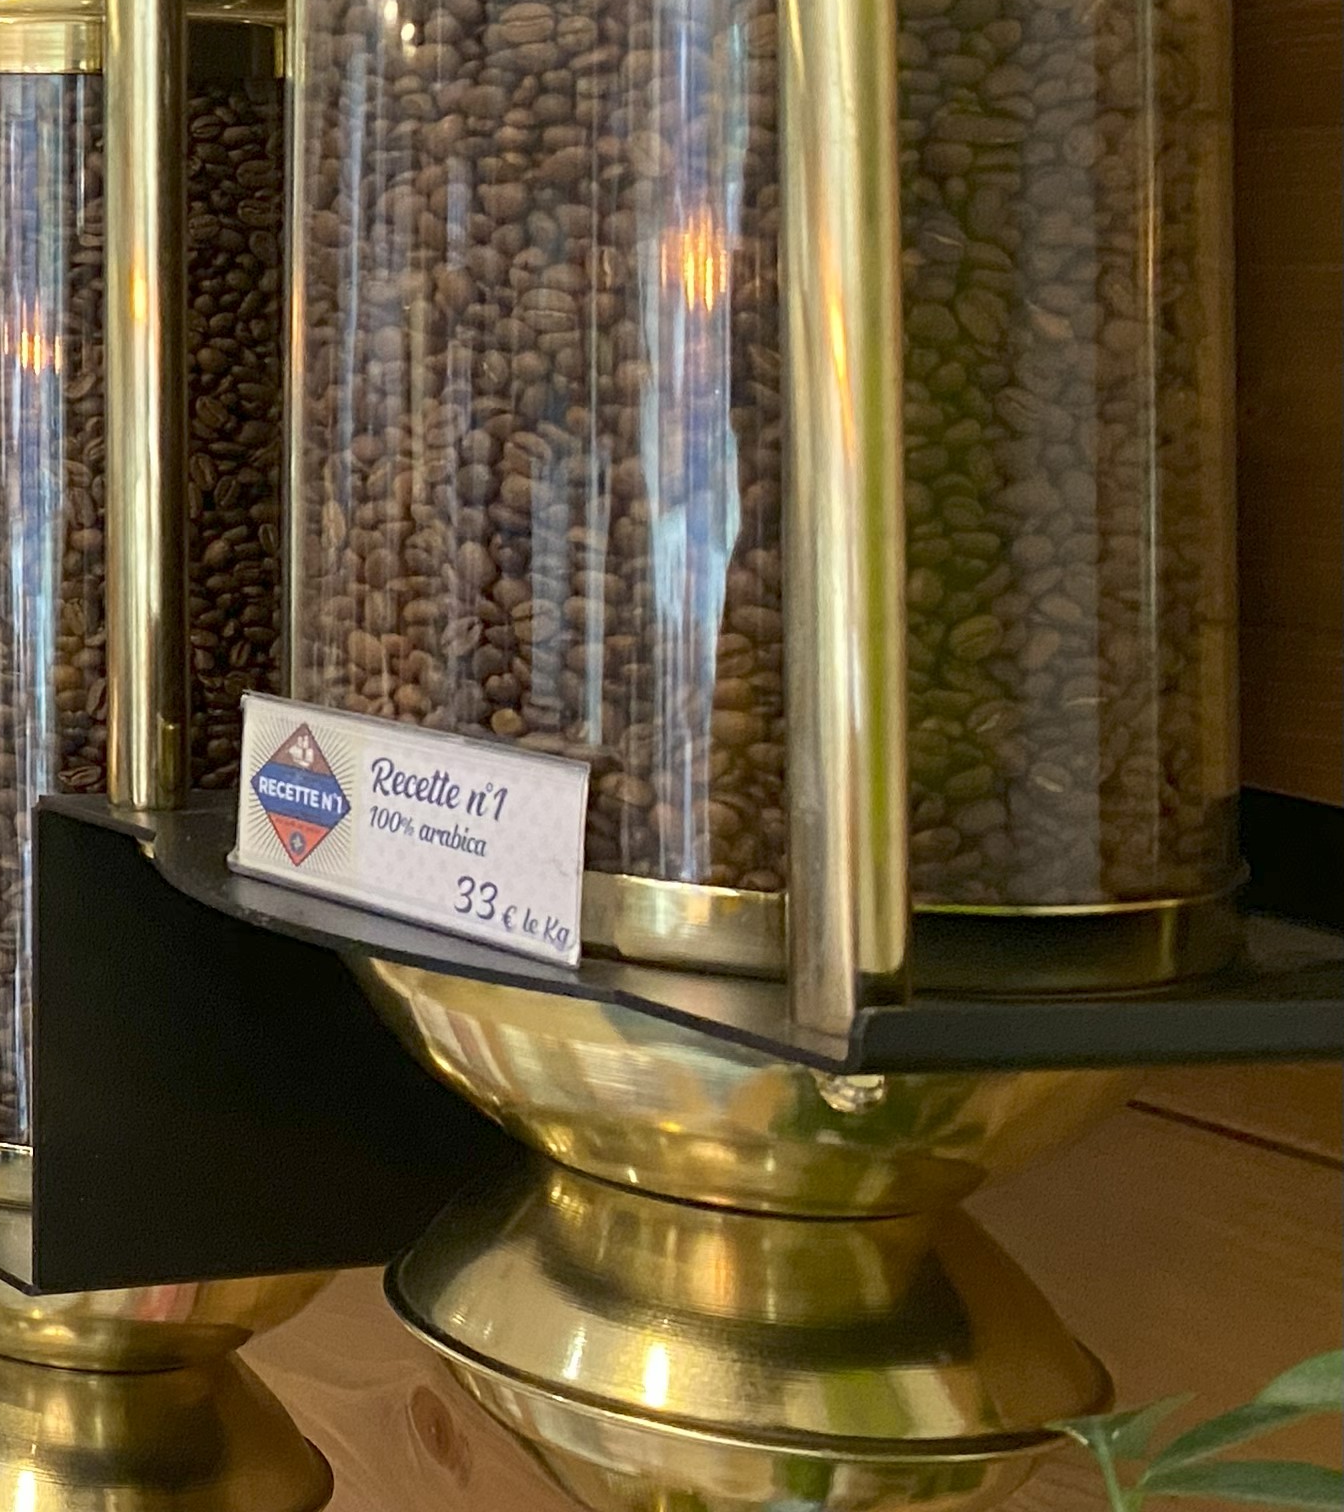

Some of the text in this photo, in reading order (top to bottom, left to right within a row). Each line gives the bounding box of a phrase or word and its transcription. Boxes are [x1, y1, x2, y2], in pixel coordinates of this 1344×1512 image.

[259, 776, 320, 808] RECETTE
[371, 757, 461, 809] Recette
[370, 805, 488, 857] 100% arabica
[454, 875, 498, 920] 33
[502, 904, 518, 933] €
[522, 907, 539, 935] le
